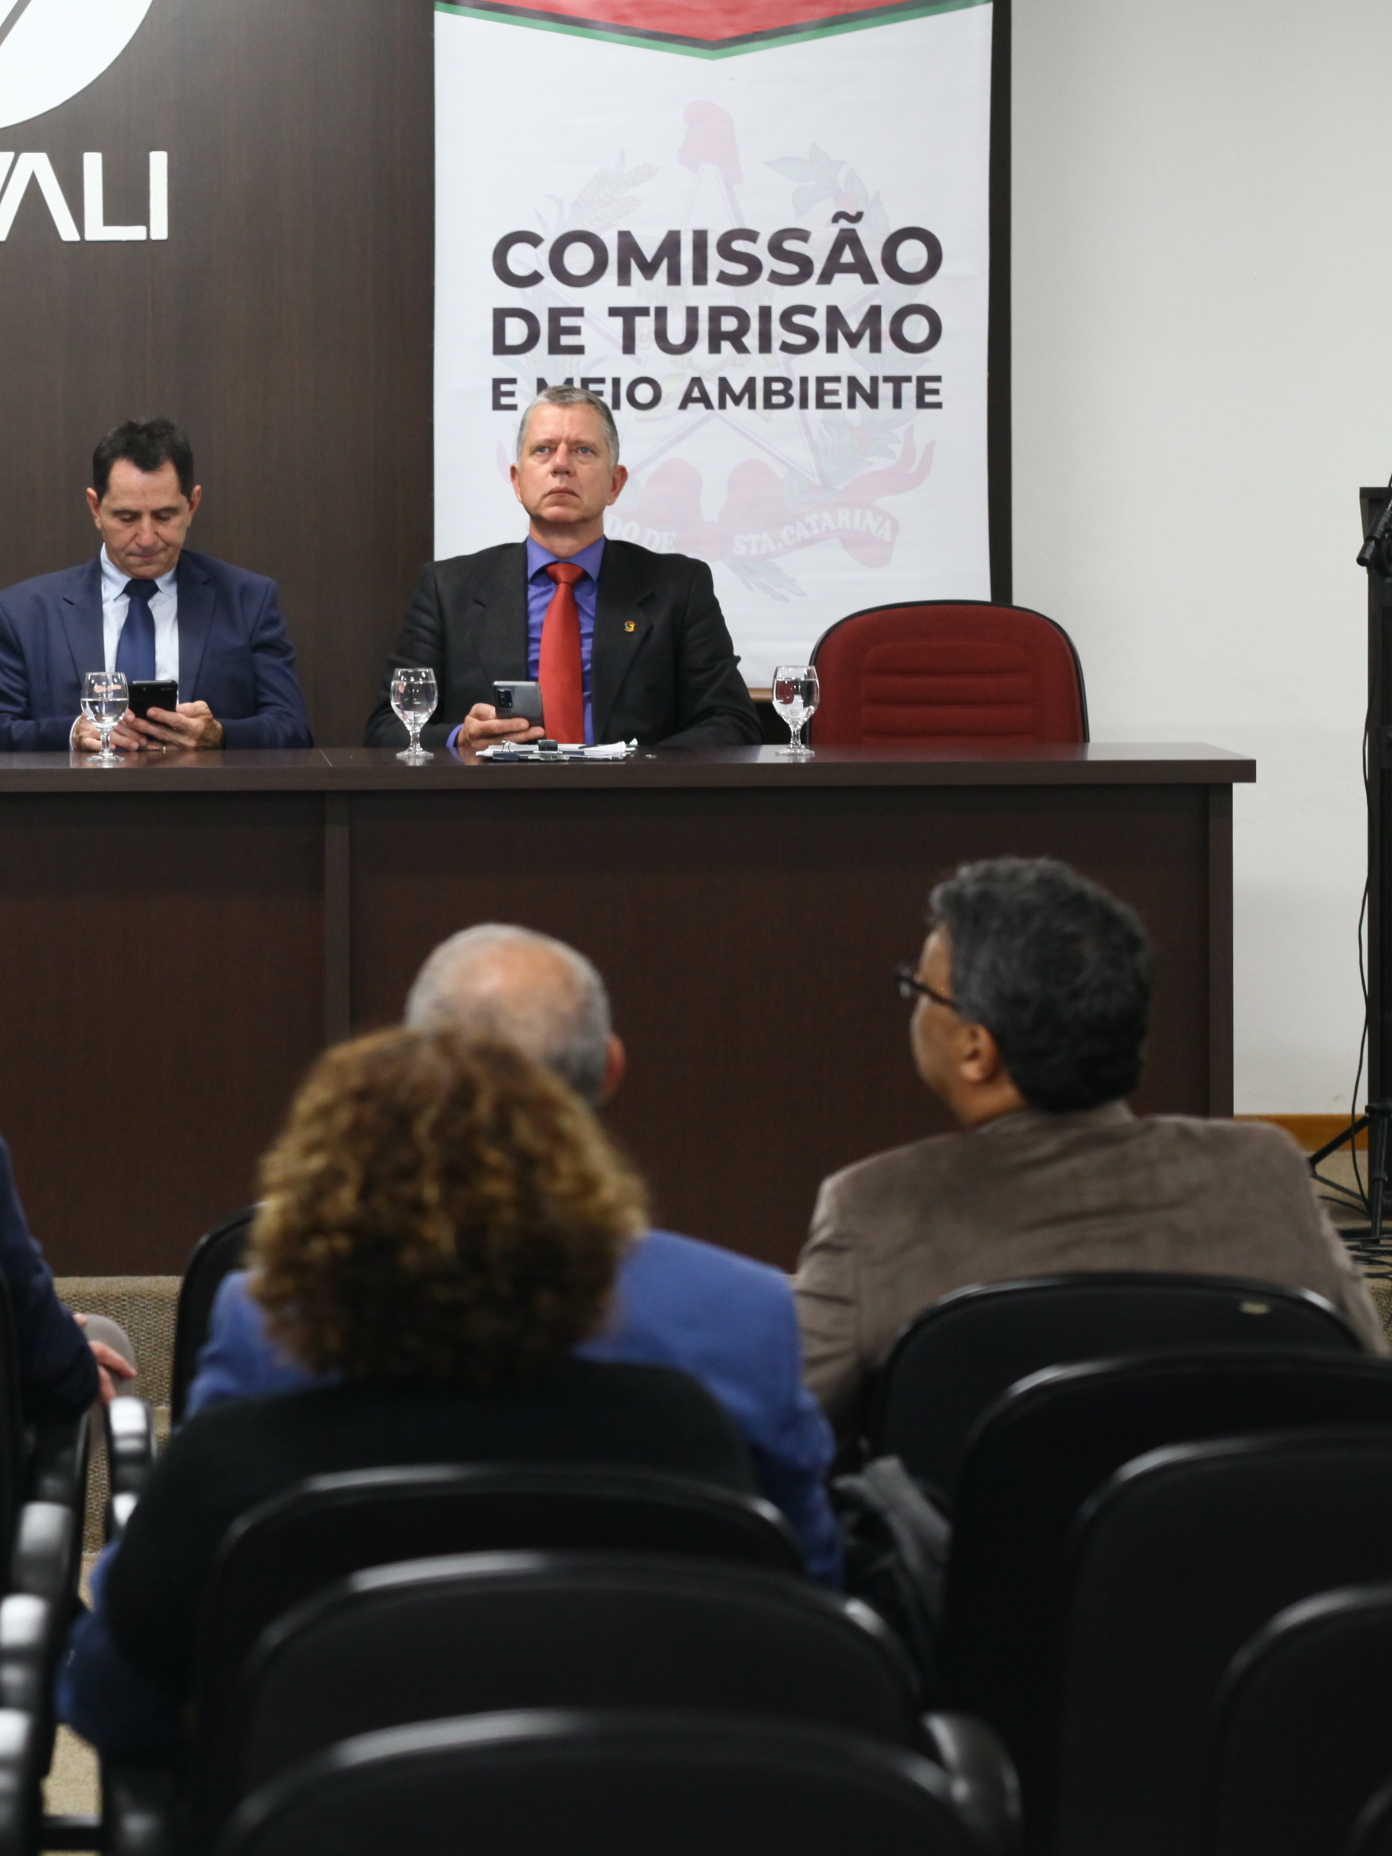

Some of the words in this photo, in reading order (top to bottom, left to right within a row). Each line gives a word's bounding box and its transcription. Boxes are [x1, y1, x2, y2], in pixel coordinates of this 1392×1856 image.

[492, 210, 943, 289] COMISSÃO
[492, 306, 585, 356] DE
[608, 303, 943, 356] TURISMO
[492, 377, 518, 411] E
[678, 375, 943, 411] AMBIENTE
